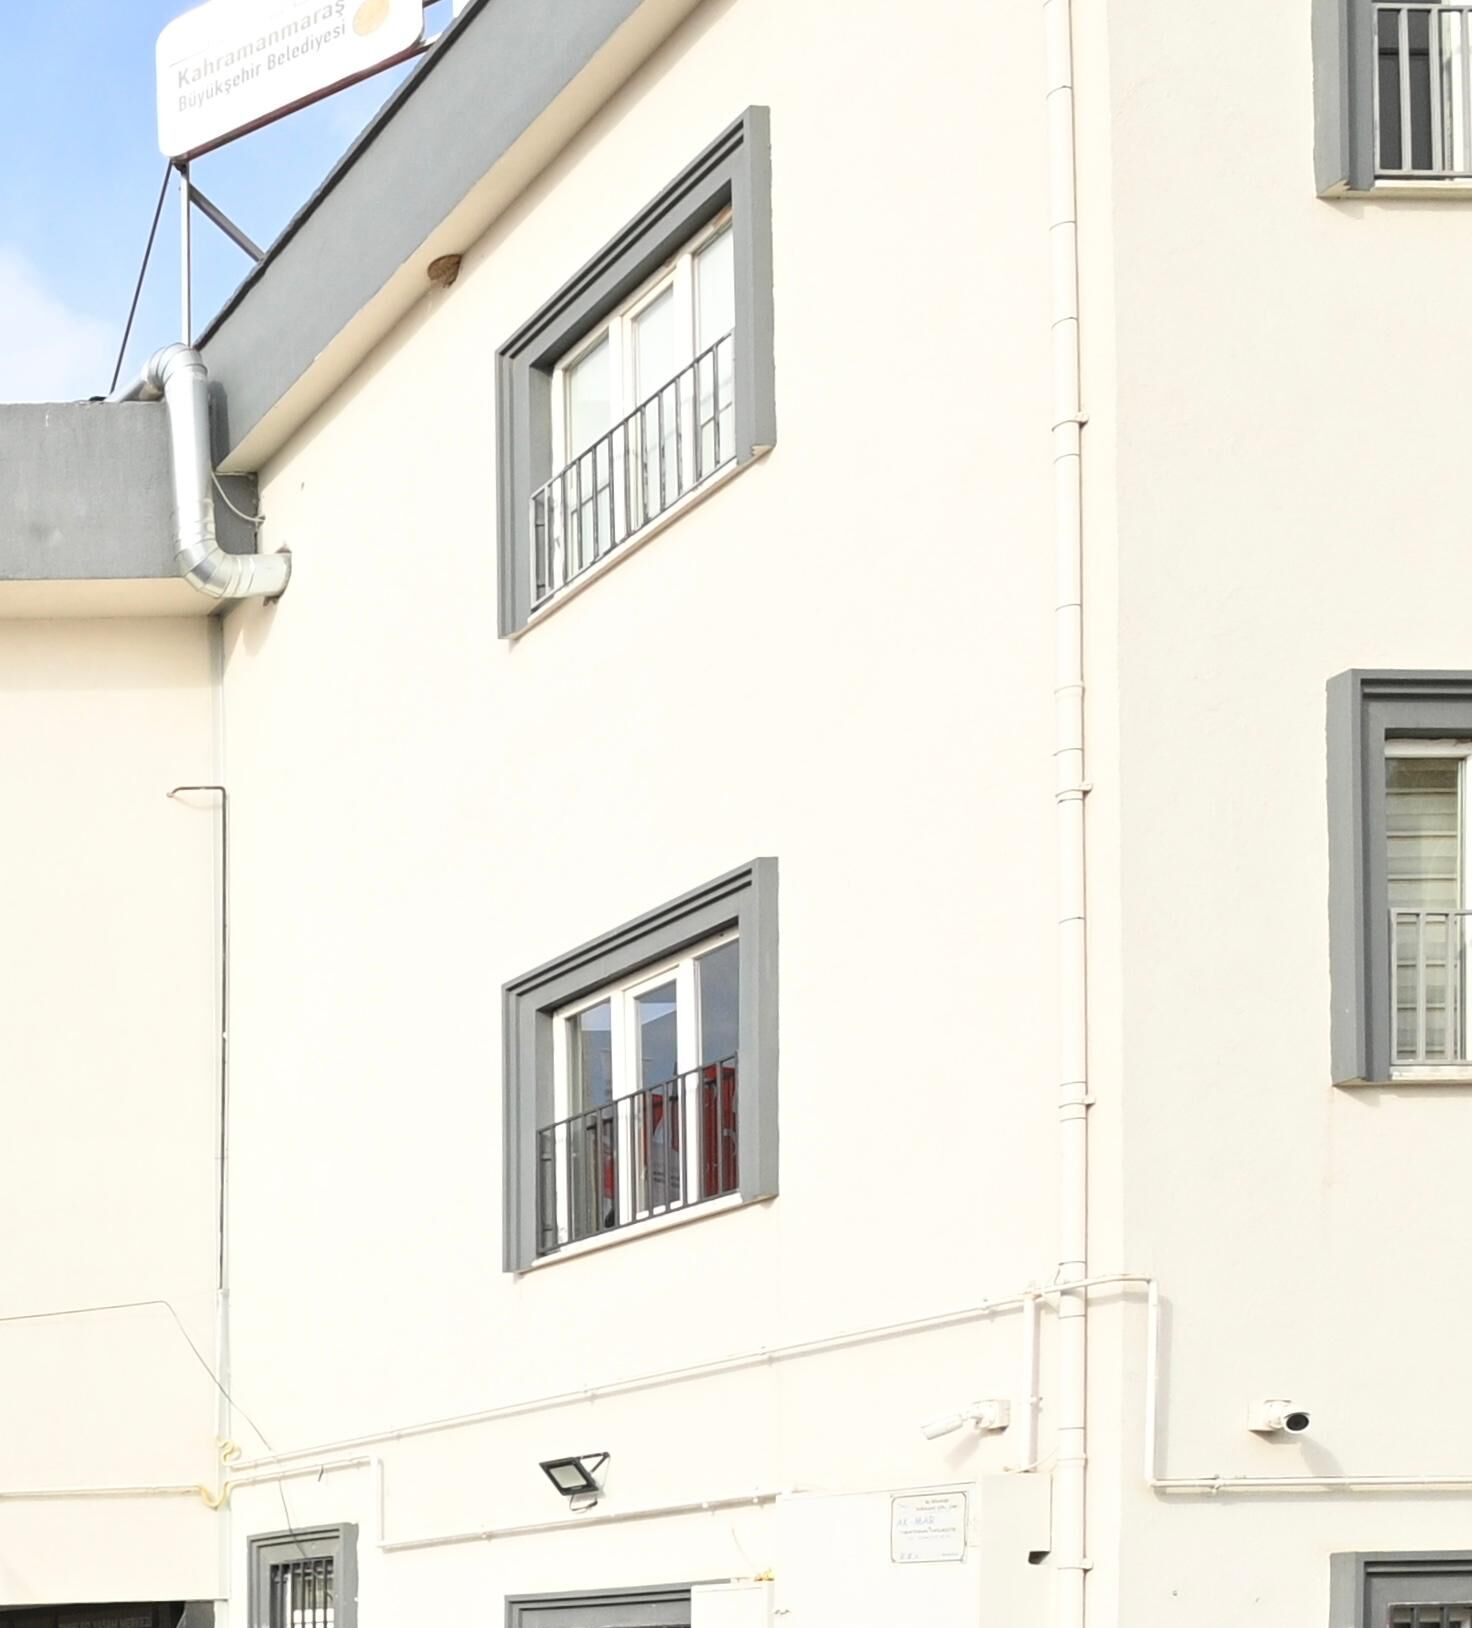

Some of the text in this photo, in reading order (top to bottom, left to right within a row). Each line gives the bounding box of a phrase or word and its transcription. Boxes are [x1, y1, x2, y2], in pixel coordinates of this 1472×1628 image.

[177, 1, 346, 89] Kahramanmaraş
[177, 22, 347, 112] Büyükşehir Belediyesi
